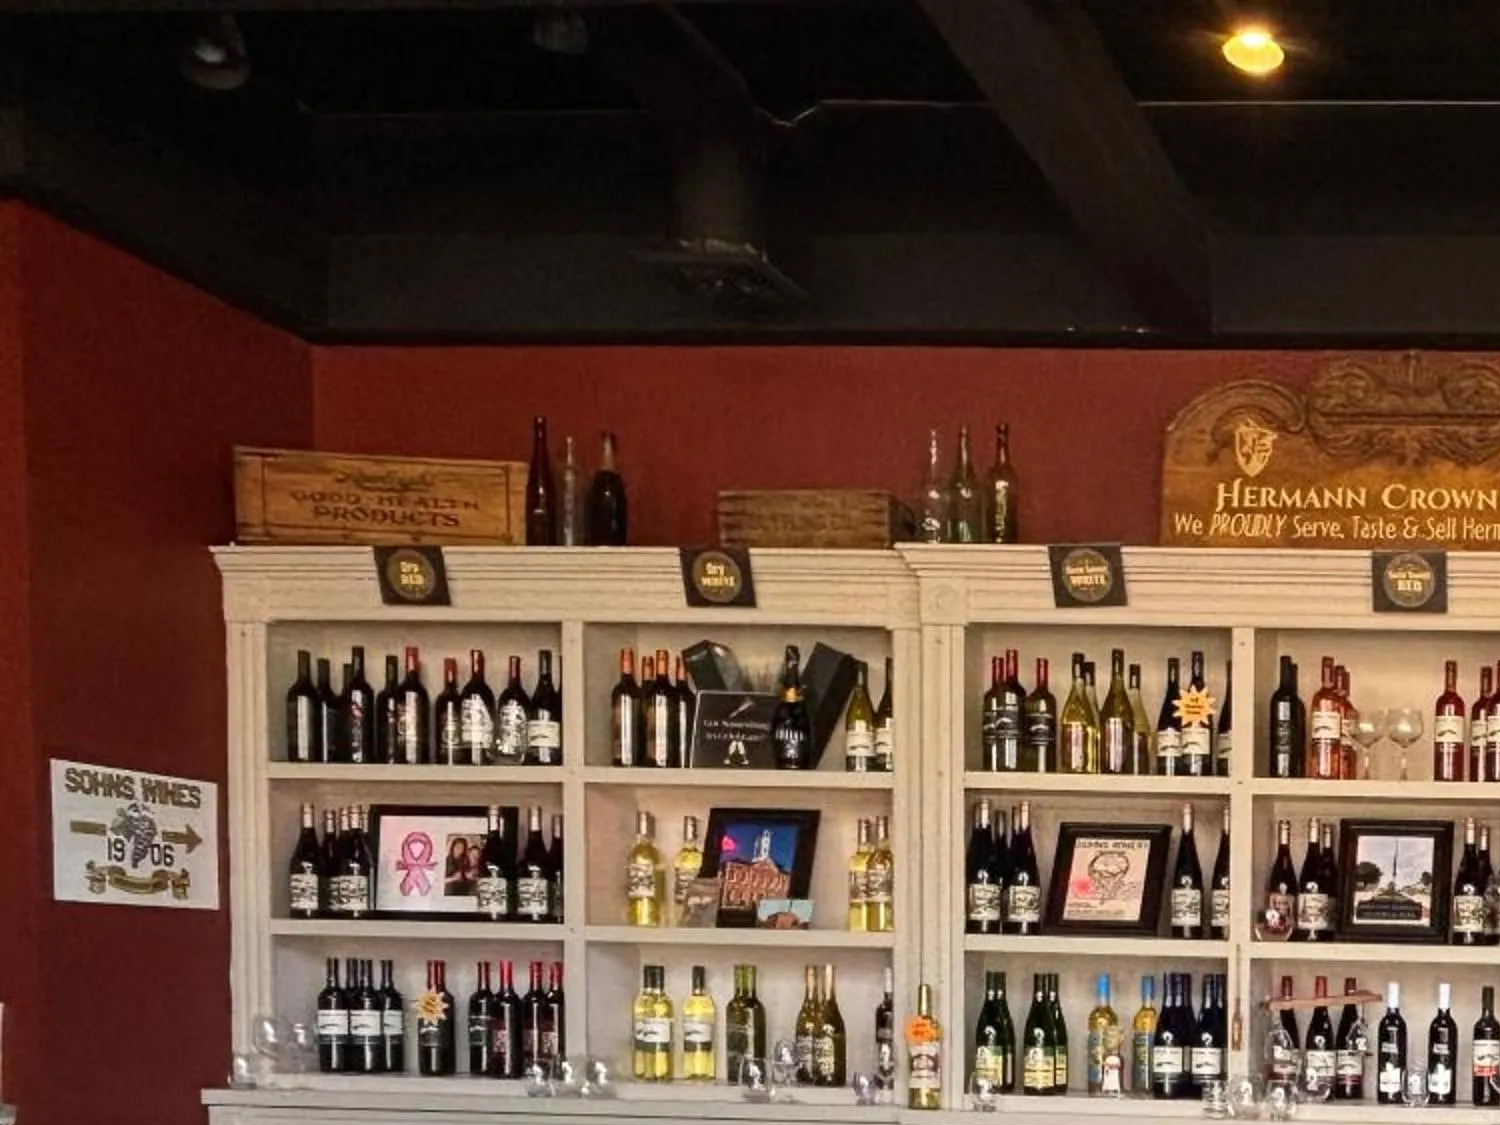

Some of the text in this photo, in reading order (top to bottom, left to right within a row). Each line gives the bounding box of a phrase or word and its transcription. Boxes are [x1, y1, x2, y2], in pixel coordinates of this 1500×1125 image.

[1215, 479, 1367, 511] HERMANN
[1381, 483, 1498, 511] CROWN
[1175, 513, 1202, 535] We
[1209, 513, 1284, 536] PROUDLY
[1352, 516, 1396, 539] Taste
[1403, 518, 1419, 539] &
[1427, 516, 1457, 540] Sell
[64, 768, 201, 809] SOHNS WINES
[107, 838, 126, 862] 19
